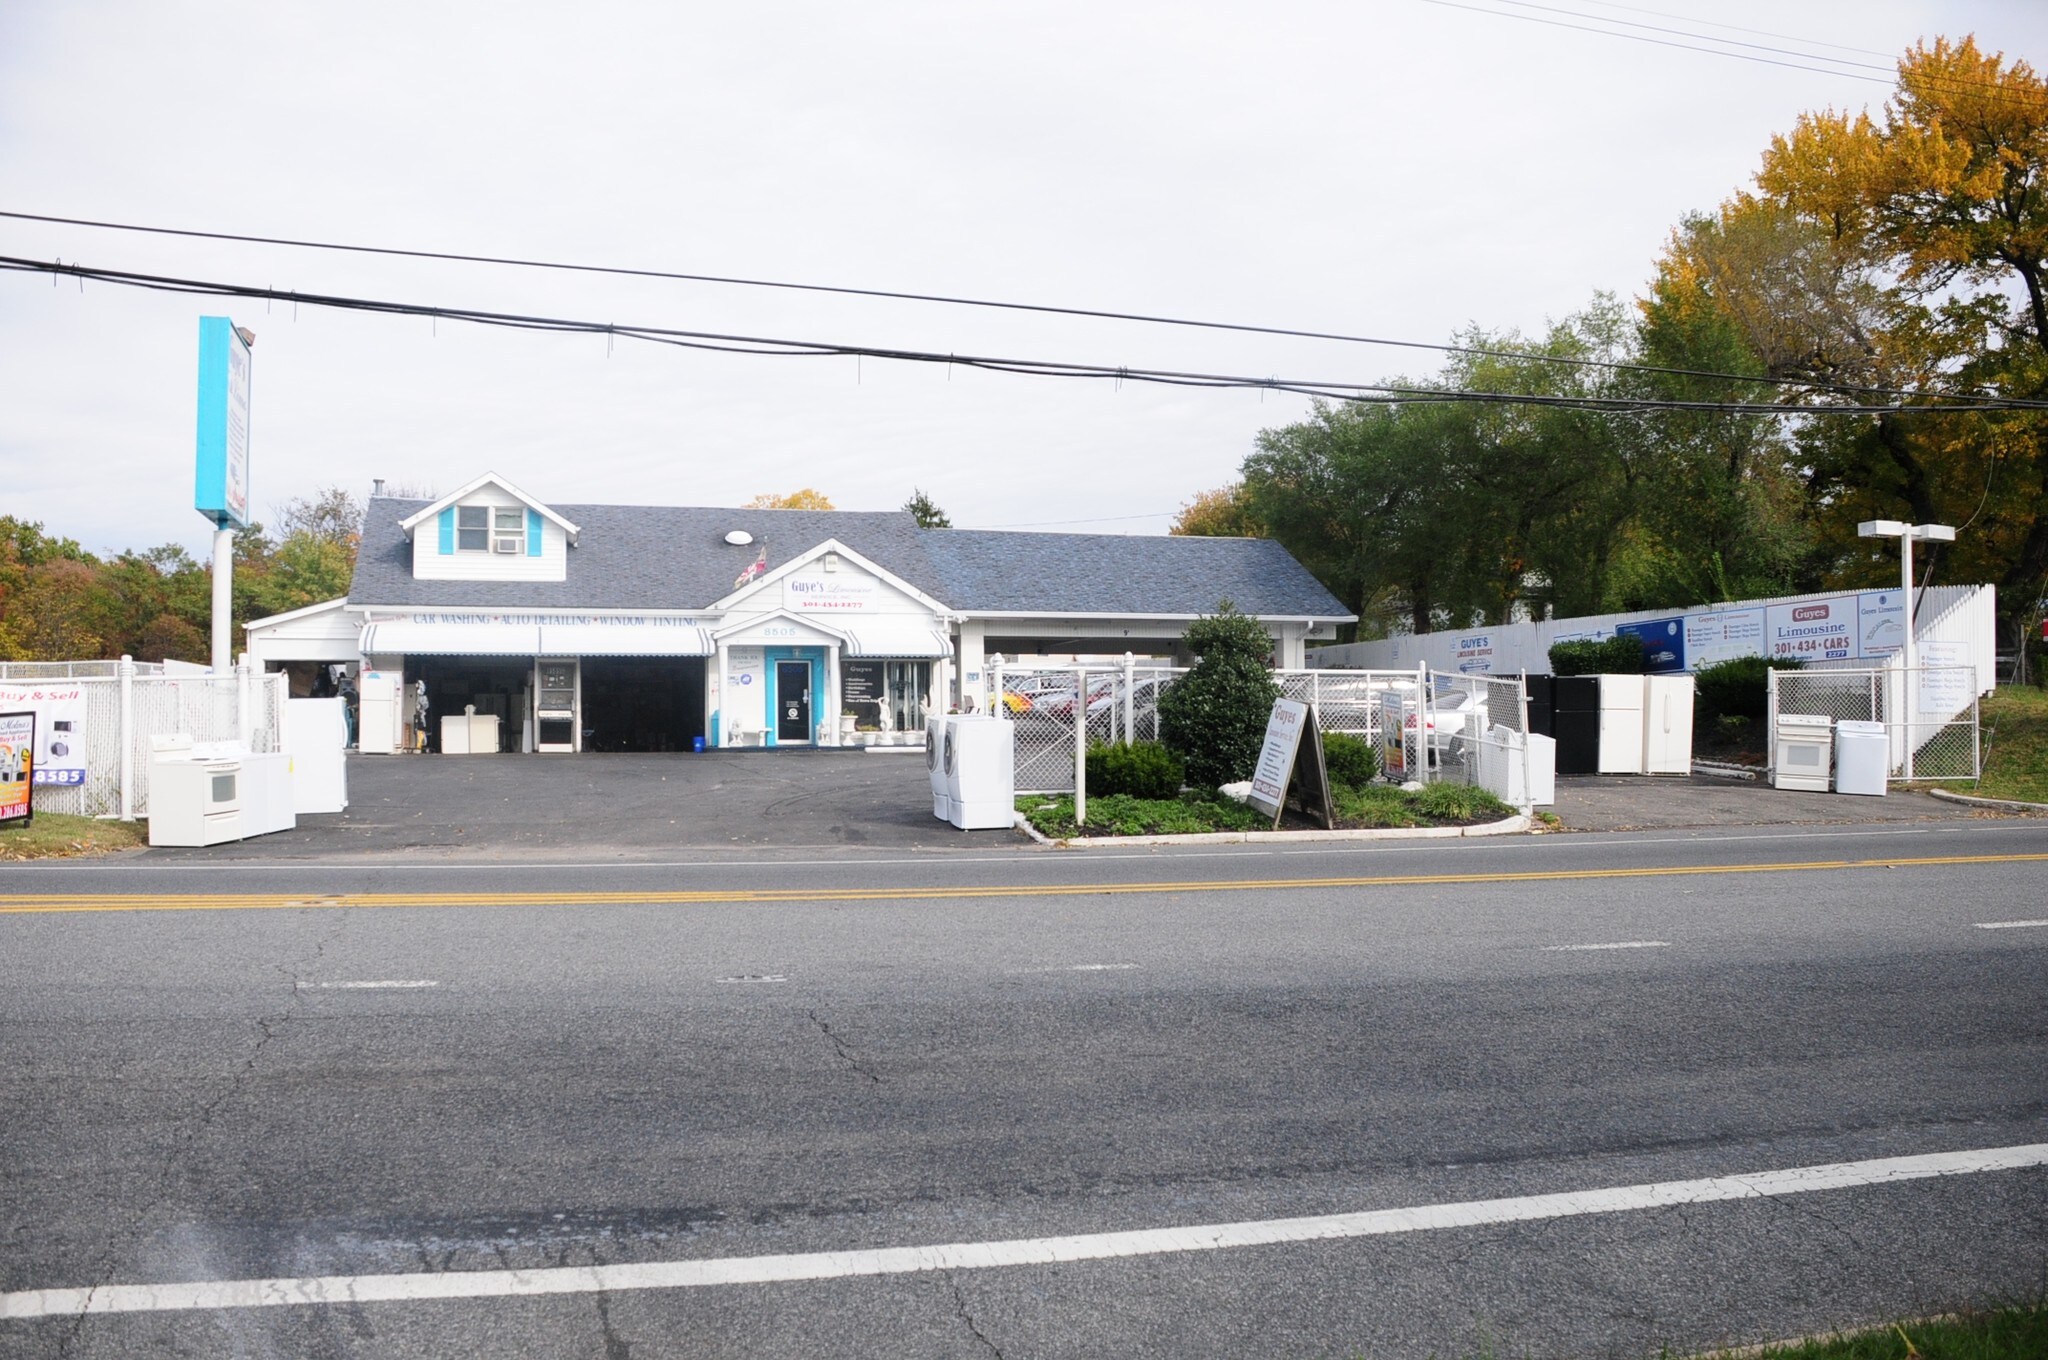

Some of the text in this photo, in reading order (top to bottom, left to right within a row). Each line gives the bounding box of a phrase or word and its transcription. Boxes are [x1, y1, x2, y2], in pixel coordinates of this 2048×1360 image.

[791, 580, 825, 593] Guye's
[1795, 608, 1826, 620] Guyes
[413, 614, 437, 624] CAR
[441, 614, 490, 625] WASHING
[501, 615, 530, 625] AUTO
[534, 615, 591, 626] DETAILING
[600, 616, 646, 627] WINDOW
[653, 617, 698, 627] TINTING
[764, 627, 796, 636] 8505
[1778, 622, 1846, 638] Limousine
[1461, 637, 1489, 649] GUYE'S
[31, 691, 44, 700] &
[49, 691, 79, 700] Sell
[35, 770, 80, 783] 8585
